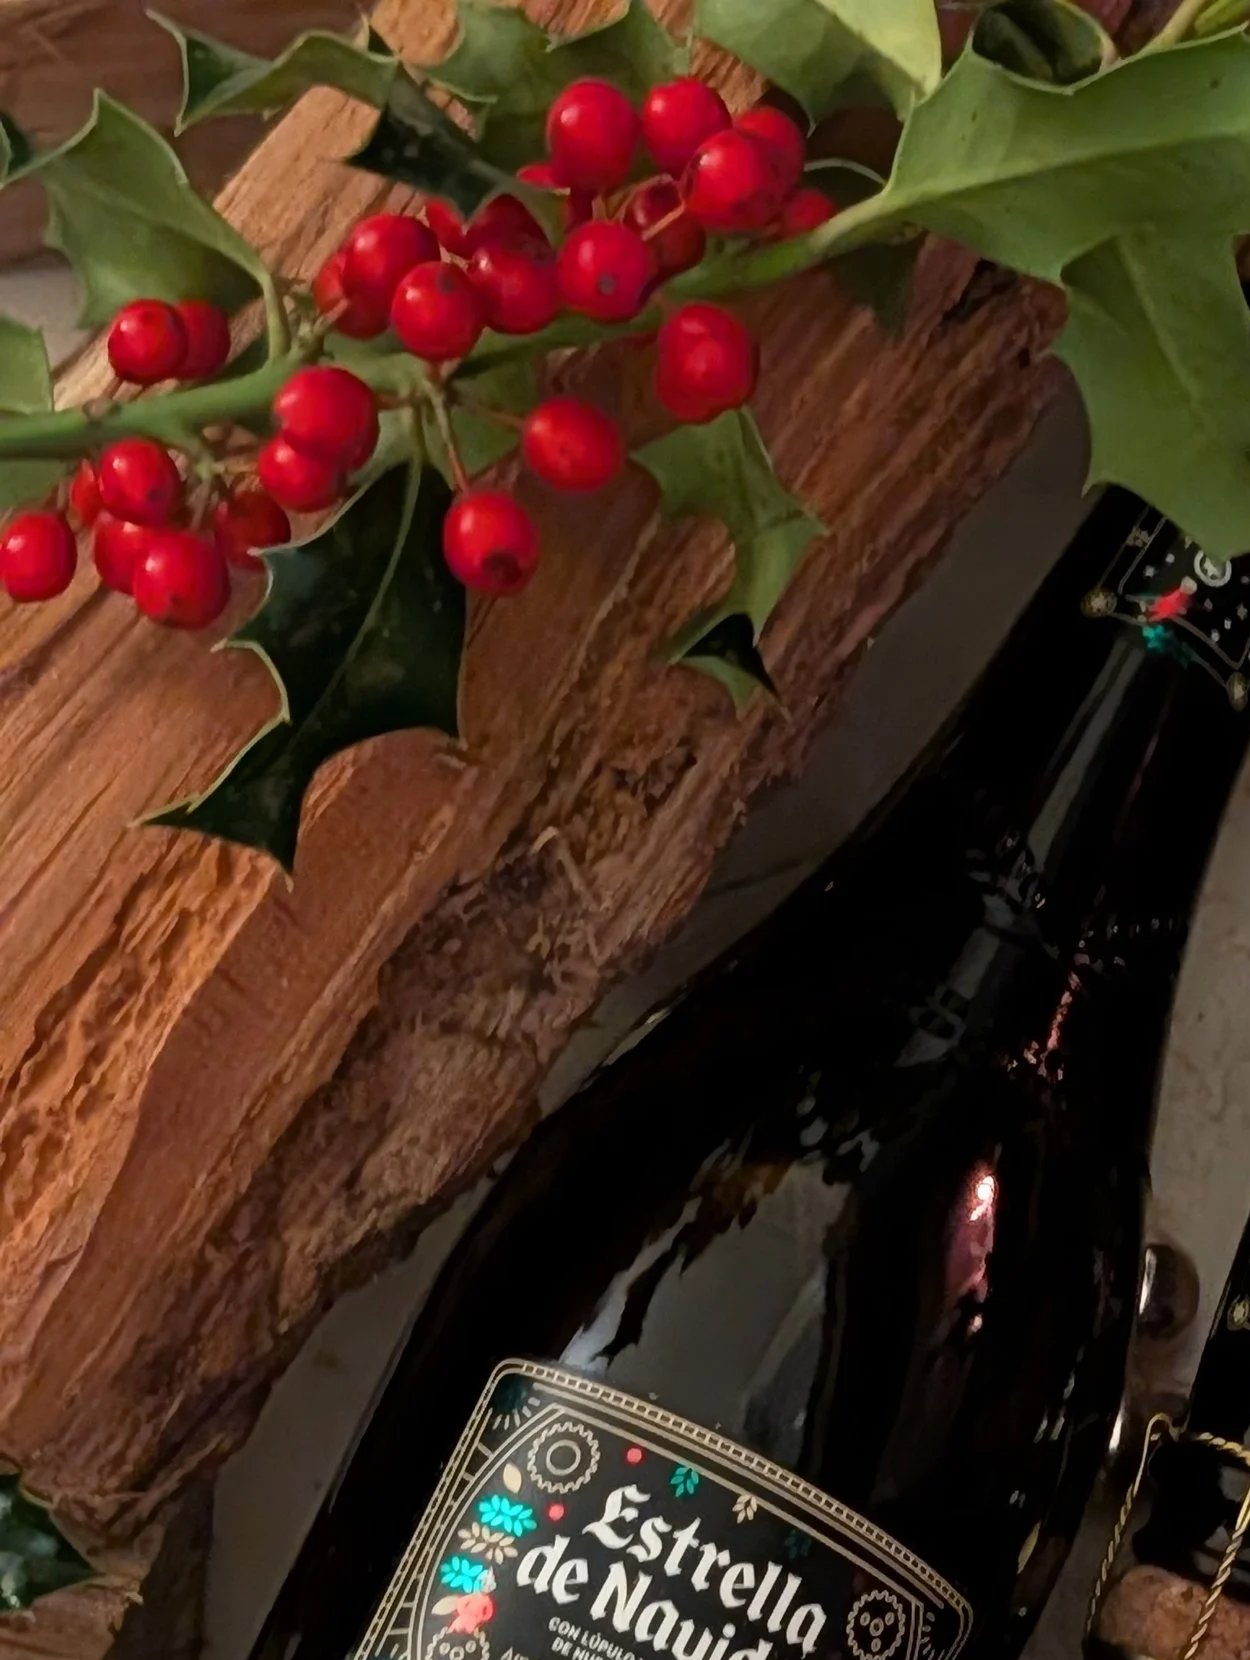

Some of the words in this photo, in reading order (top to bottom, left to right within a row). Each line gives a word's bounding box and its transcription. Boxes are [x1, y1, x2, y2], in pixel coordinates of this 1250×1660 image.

[516, 1534, 588, 1604] de
[582, 1484, 826, 1658] Estrella
[548, 1617, 581, 1641] CON
[551, 1637, 573, 1656] DE
